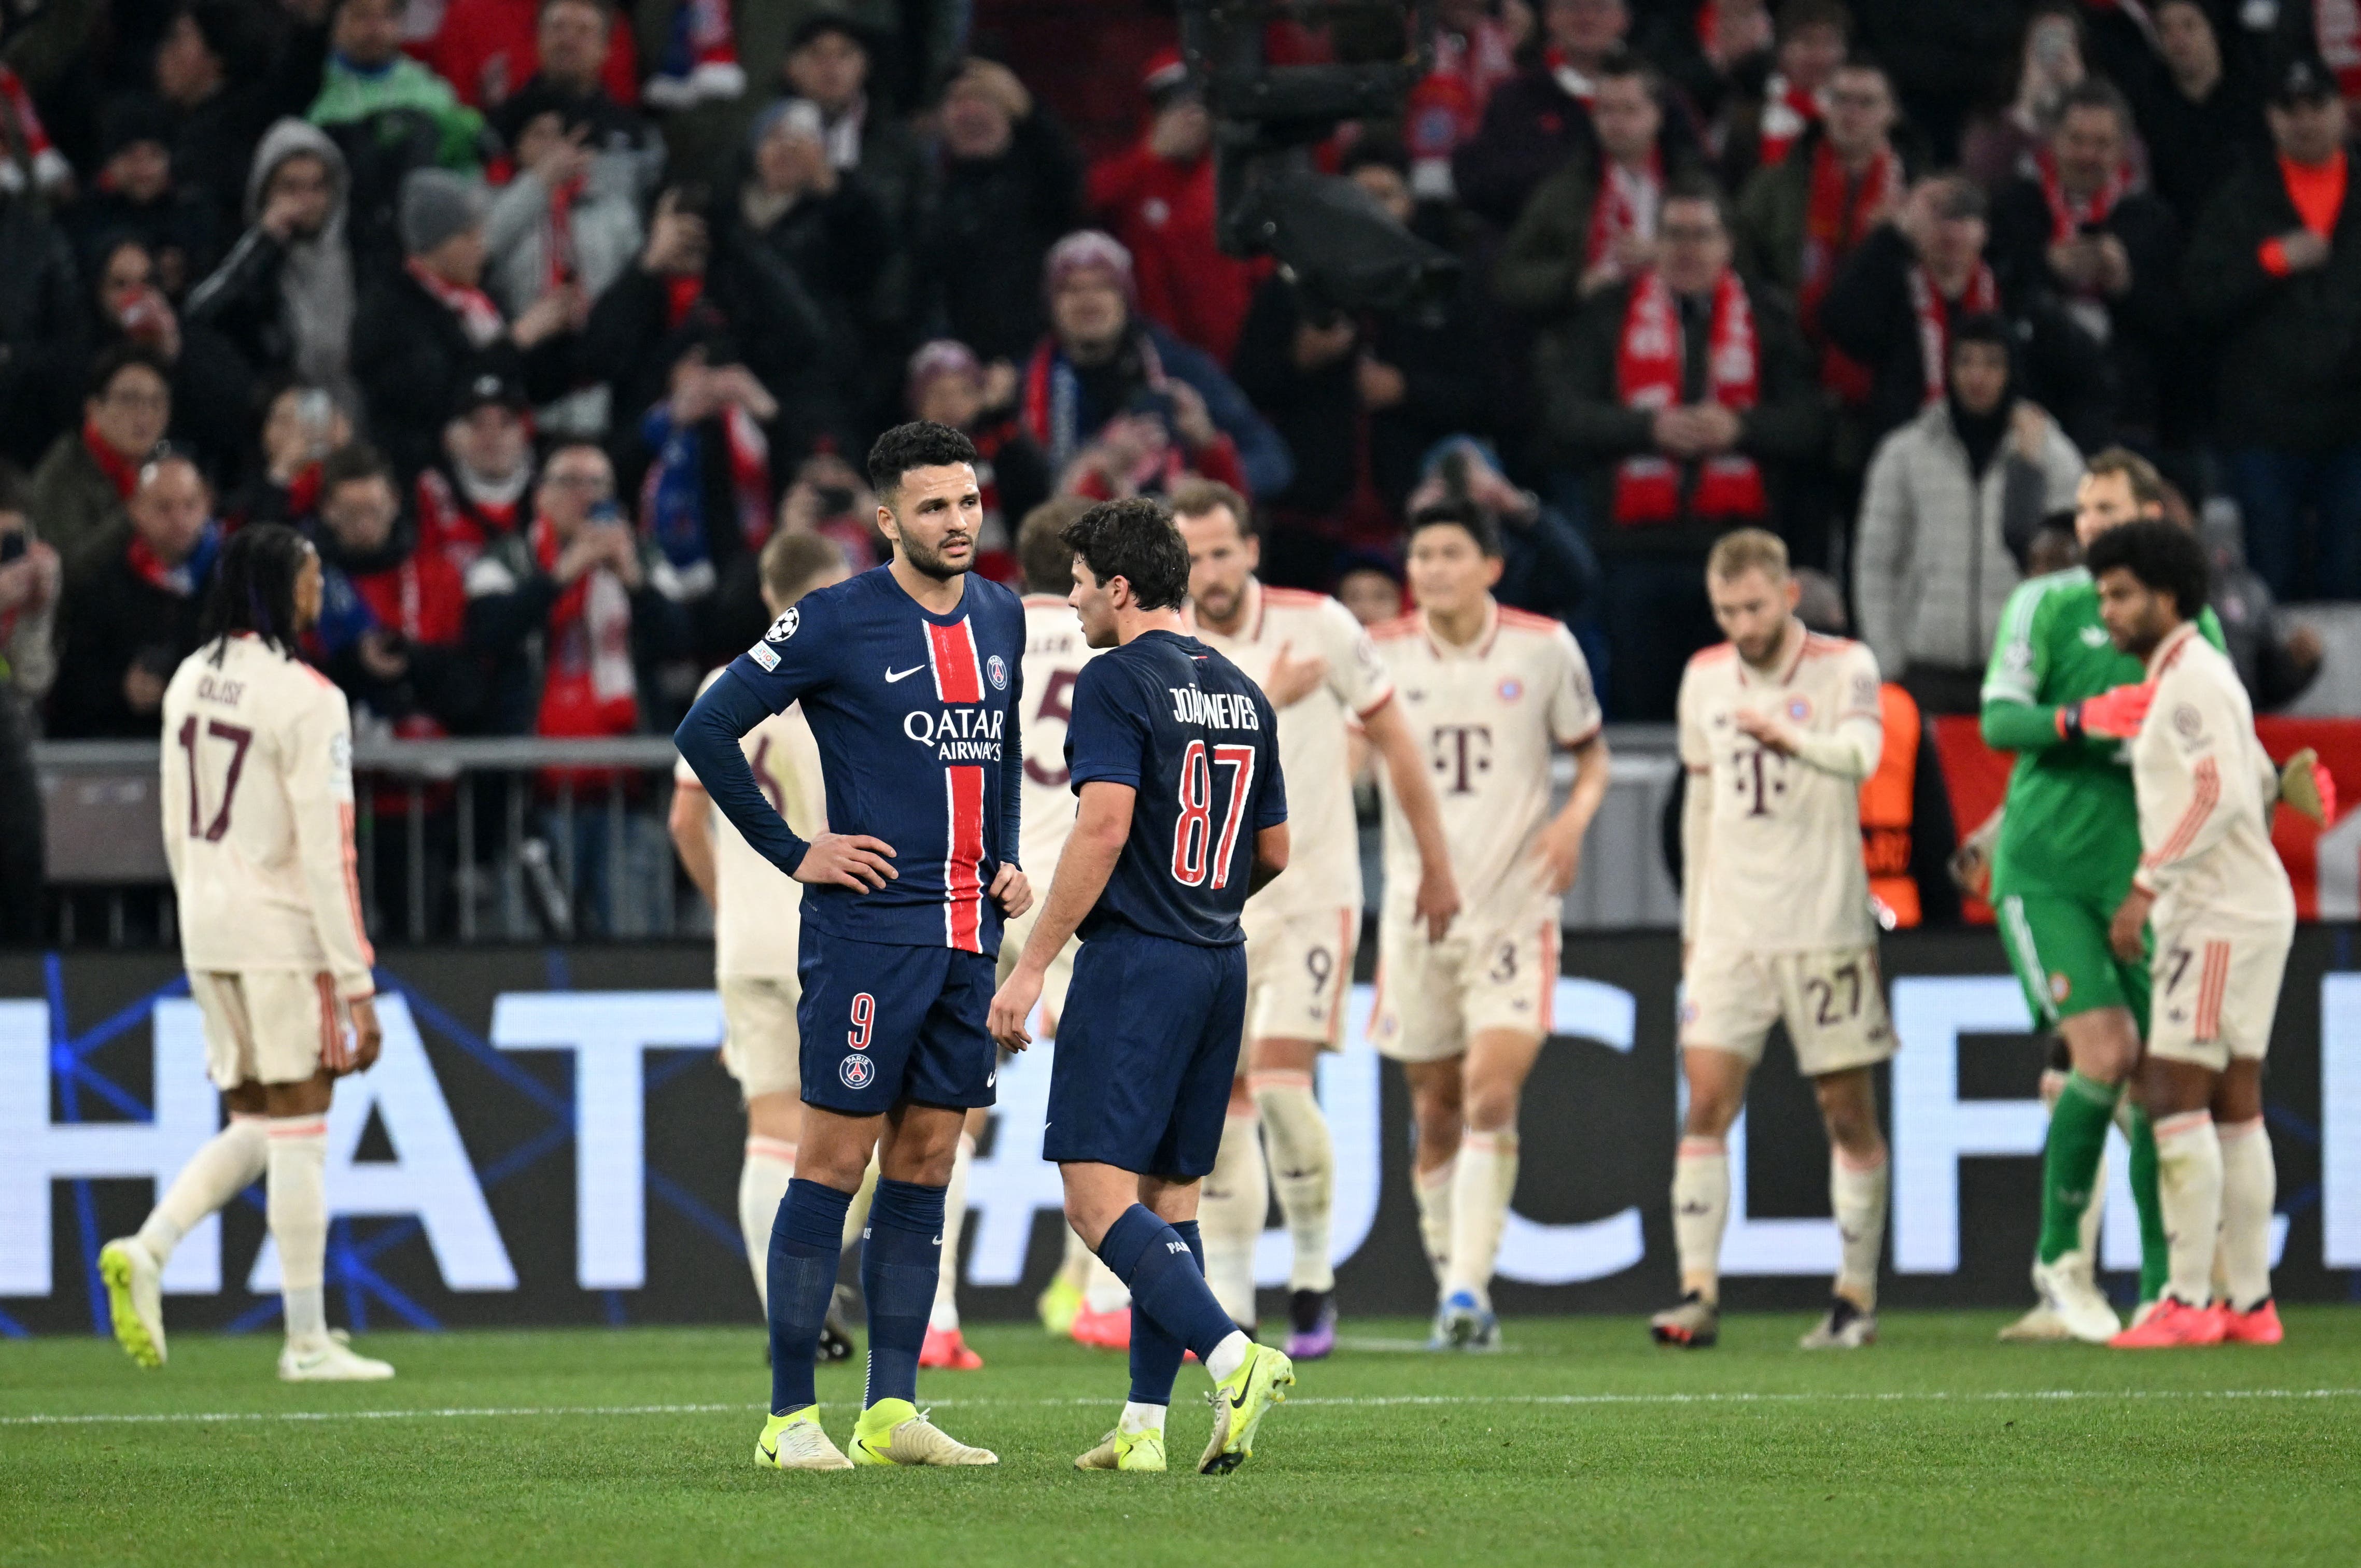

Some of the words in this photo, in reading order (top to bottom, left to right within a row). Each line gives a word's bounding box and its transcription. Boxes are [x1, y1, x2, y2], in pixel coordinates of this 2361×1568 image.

[990, 657, 1003, 667] PARIS
[904, 709, 1004, 747] QATAR
[1203, 694, 1259, 730] NEVES
[938, 741, 1001, 762] AIRWAYS
[179, 713, 253, 843] 17
[1171, 739, 1256, 890] 87
[1305, 946, 1333, 996] 9
[1491, 942, 1518, 983] 3
[2165, 946, 2193, 996] 7
[1805, 963, 1861, 1025] 27
[848, 992, 876, 1050] 9
[846, 1055, 869, 1065] PARIS
